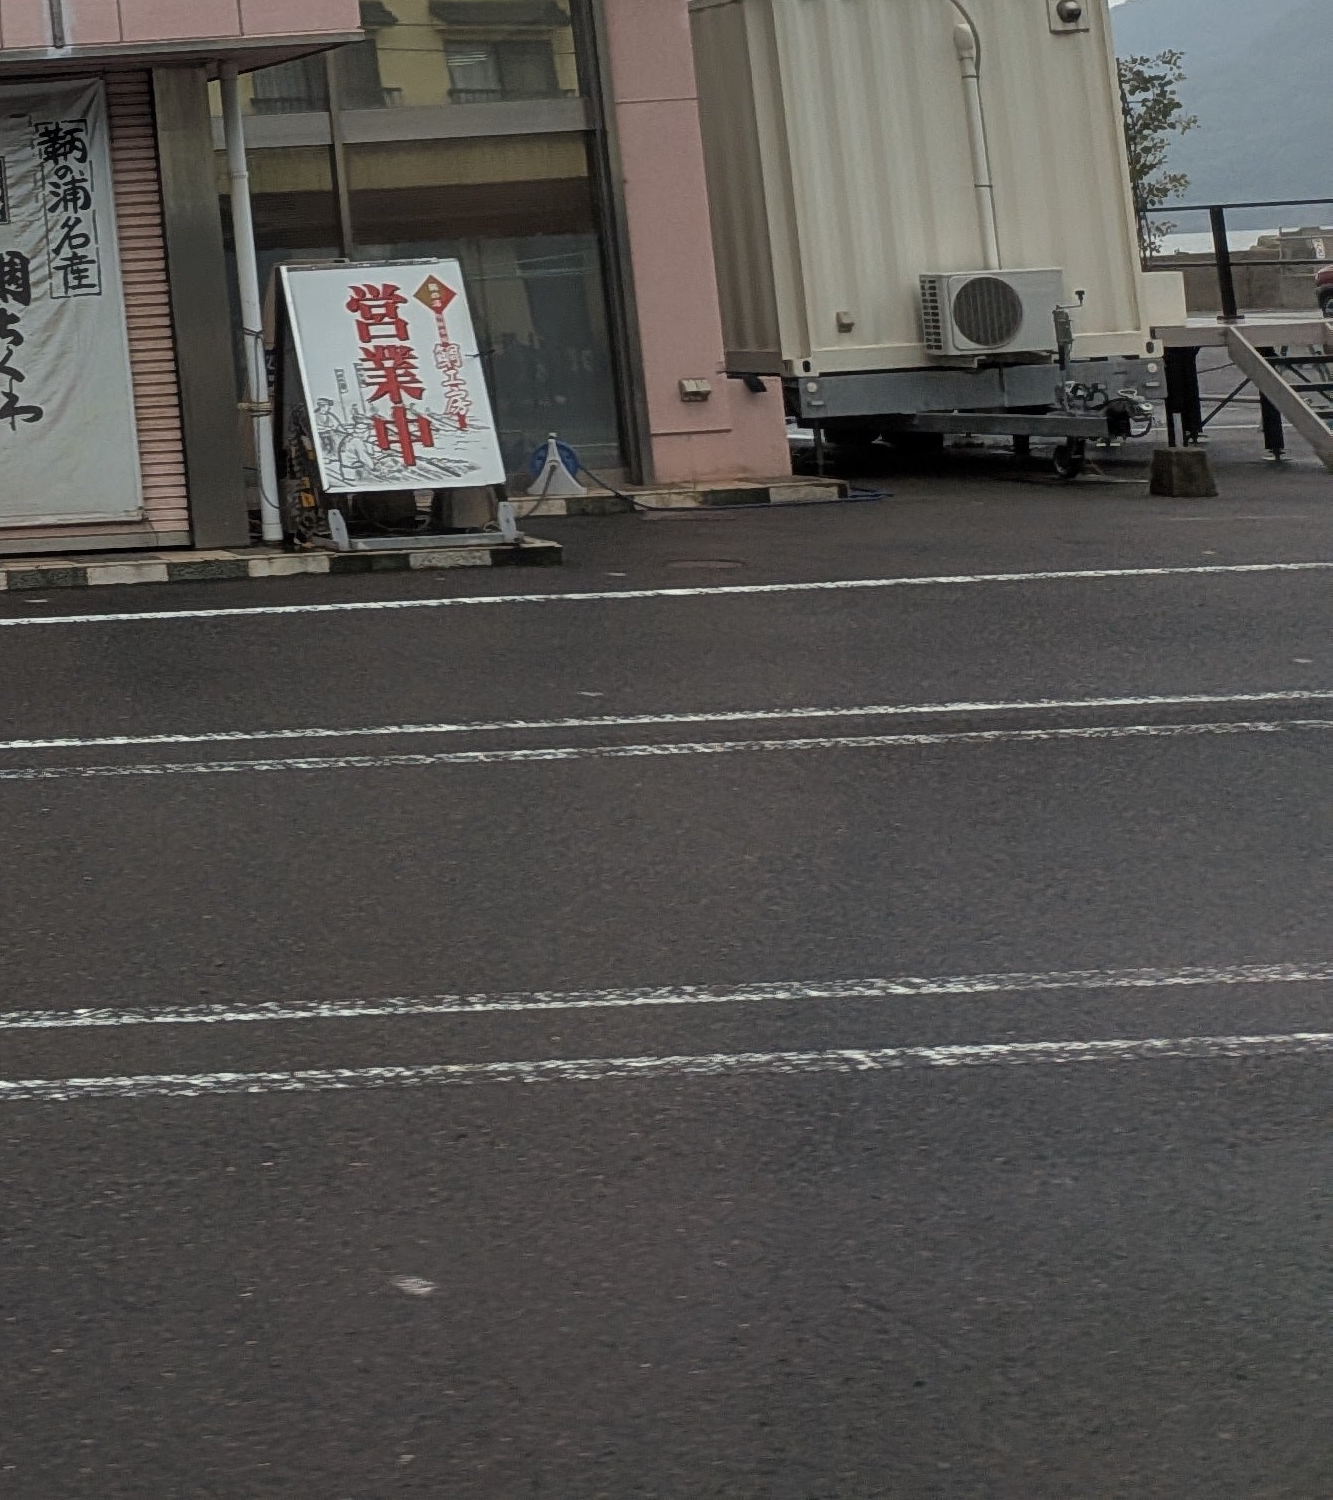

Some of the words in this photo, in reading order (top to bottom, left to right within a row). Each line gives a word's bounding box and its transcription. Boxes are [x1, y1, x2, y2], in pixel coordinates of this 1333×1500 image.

[36, 121, 97, 295] 鞆の浦名産
[345, 283, 434, 467] 営業中
